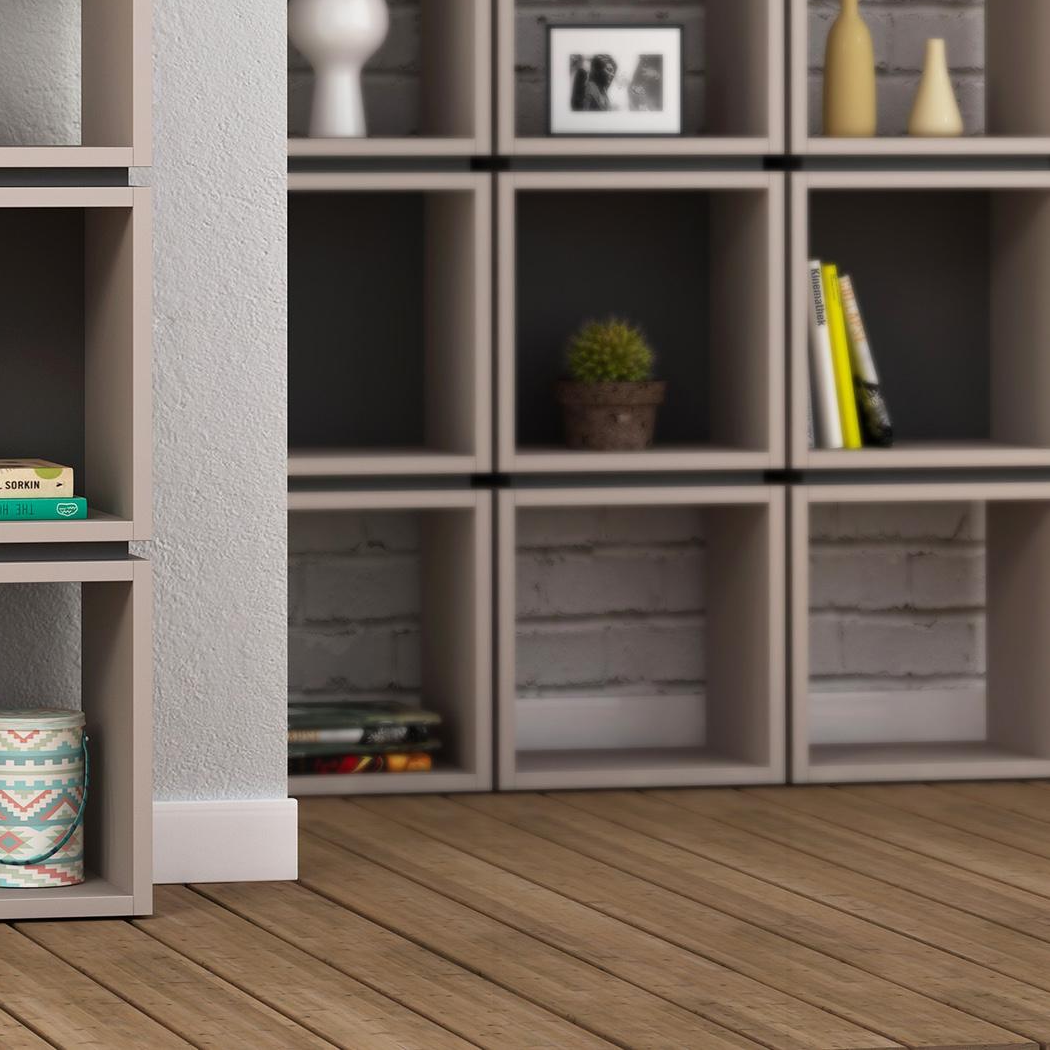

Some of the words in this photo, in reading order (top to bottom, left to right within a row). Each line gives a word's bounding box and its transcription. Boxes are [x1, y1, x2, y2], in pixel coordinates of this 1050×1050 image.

[810, 268, 826, 327] Kinemathek
[5, 480, 40, 490] SORKIN
[15, 503, 35, 516] THE
